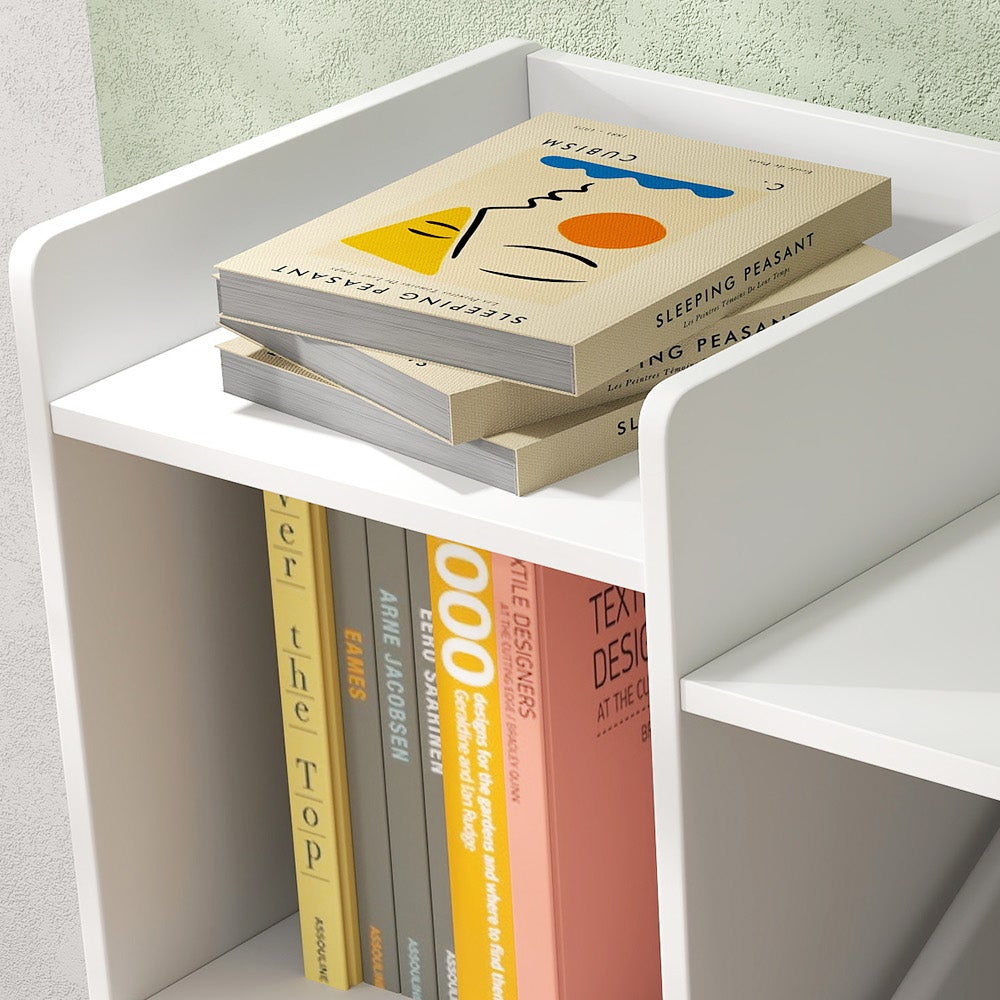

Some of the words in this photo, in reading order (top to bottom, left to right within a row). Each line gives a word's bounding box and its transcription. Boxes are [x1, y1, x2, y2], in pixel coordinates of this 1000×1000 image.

[542, 139, 637, 162] CUBISM
[271, 265, 390, 294] PEASANT
[656, 276, 735, 328] SLEEPING
[744, 232, 814, 282] PEASANT
[399, 292, 528, 324] SLEEPING
[697, 311, 799, 352] PEASA
[607, 384, 623, 392] Les
[379, 588, 400, 648] ARNE
[289, 624, 310, 722] the
[344, 627, 368, 701] EAMES
[513, 612, 537, 719] DESIGNERS
[384, 652, 410, 763] JACOBSEN
[597, 698, 610, 723] AT
[613, 685, 634, 712] THE
[458, 755, 475, 784] and
[477, 749, 492, 771] for
[478, 772, 493, 796] the
[483, 854, 499, 883] and
[486, 883, 502, 926] where
[315, 916, 329, 984] ASSOULINE
[488, 926, 501, 941] to
[489, 943, 505, 972] find
